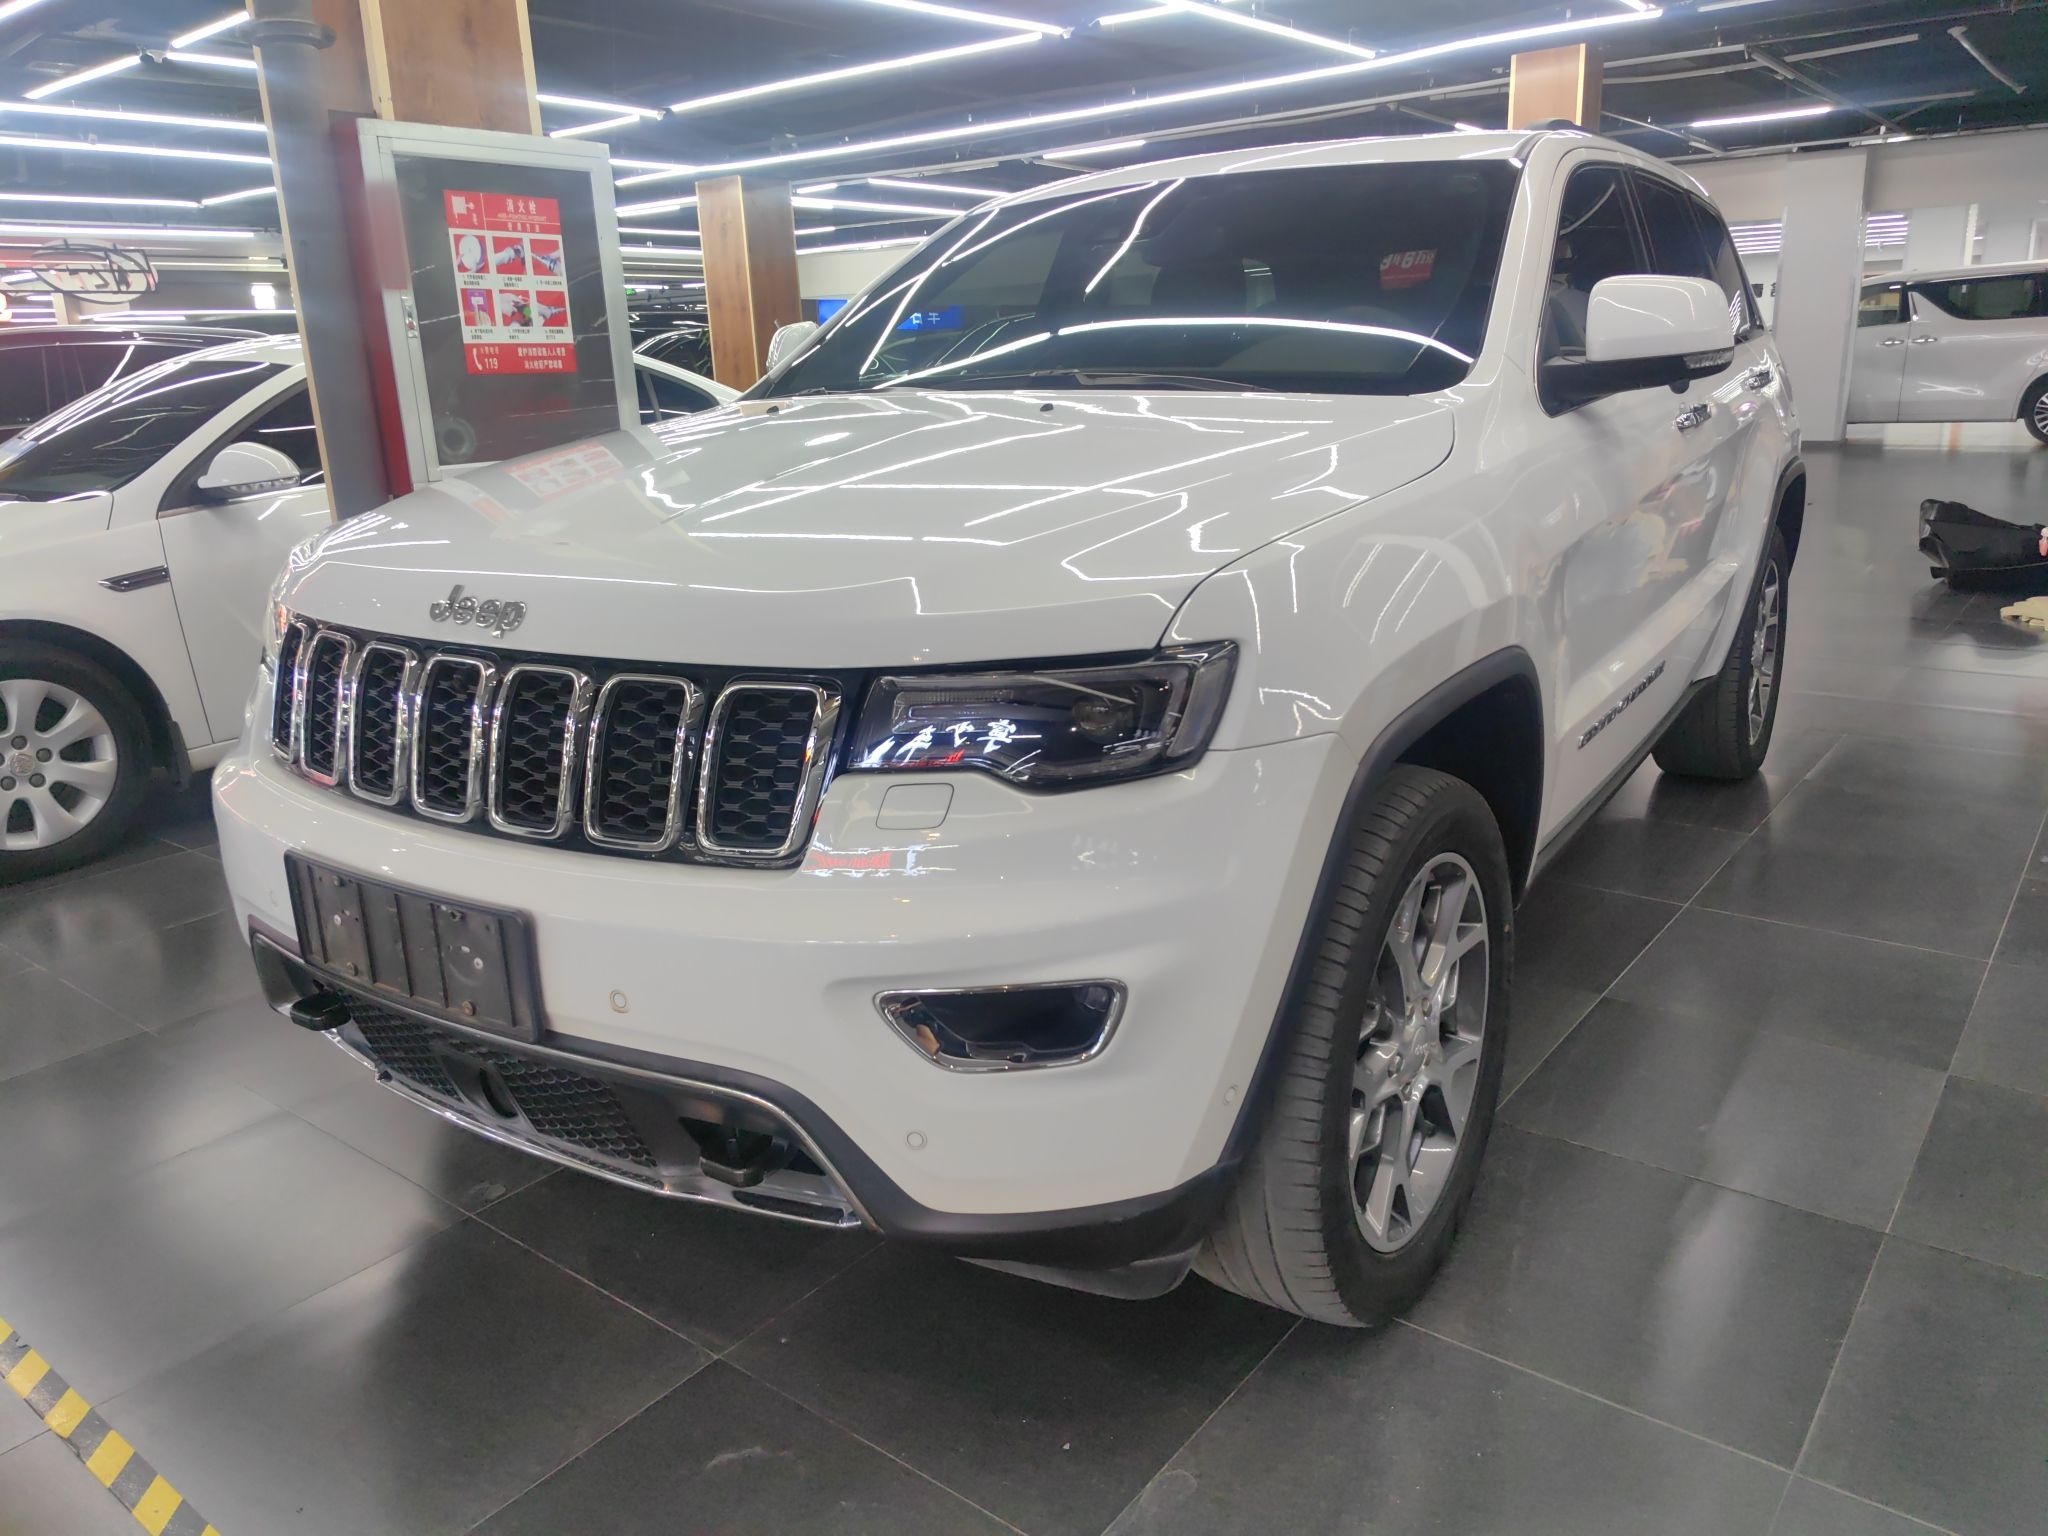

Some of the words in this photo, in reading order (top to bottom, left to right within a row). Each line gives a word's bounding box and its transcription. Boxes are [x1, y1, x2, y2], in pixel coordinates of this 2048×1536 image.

[506, 198, 537, 215] 消火栓
[484, 357, 499, 370] 119
[429, 584, 527, 639] Jeep
